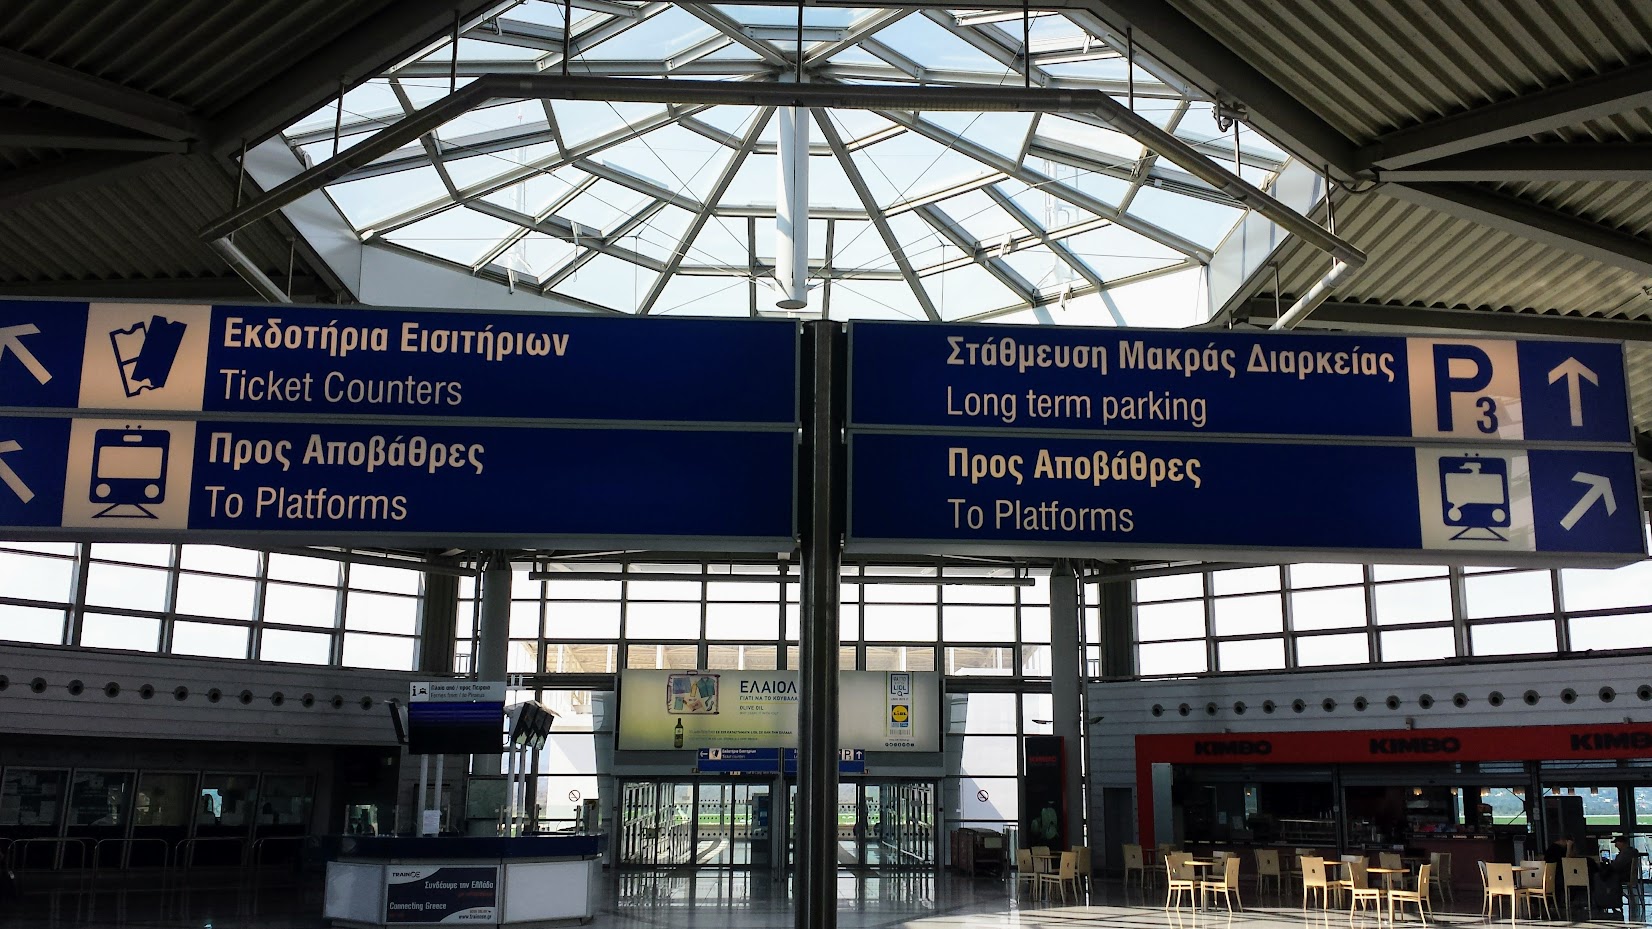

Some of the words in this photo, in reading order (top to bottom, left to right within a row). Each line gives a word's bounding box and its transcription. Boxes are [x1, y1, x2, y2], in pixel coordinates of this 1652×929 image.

[224, 317, 388, 354] Εκδοτήρια
[401, 322, 570, 361] Εισιτήριων
[947, 336, 1108, 376] Στάθμευση
[1119, 341, 1236, 379] Μακράς
[1246, 343, 1395, 383] Διαρκείας
[220, 369, 313, 402] Ticket
[324, 371, 462, 406] Counters
[947, 385, 1017, 423] Long
[1026, 389, 1091, 418] term
[1102, 391, 1207, 427] parking
[209, 432, 291, 471] Προς
[303, 434, 485, 475] Αποβάθρες
[948, 448, 1023, 485] Προς
[1033, 449, 1201, 489] Αποβάθρες
[205, 486, 244, 518] To
[256, 486, 407, 521] Platforms
[947, 498, 984, 529] To
[995, 500, 1134, 532] Platforms
[740, 680, 798, 693] ΕΛΑΙΟΛ
[1194, 740, 1272, 755] KIMBO
[1369, 737, 1461, 755] KIMBO
[1570, 732, 1652, 751] KIMB
[389, 902, 424, 911] Connecting
